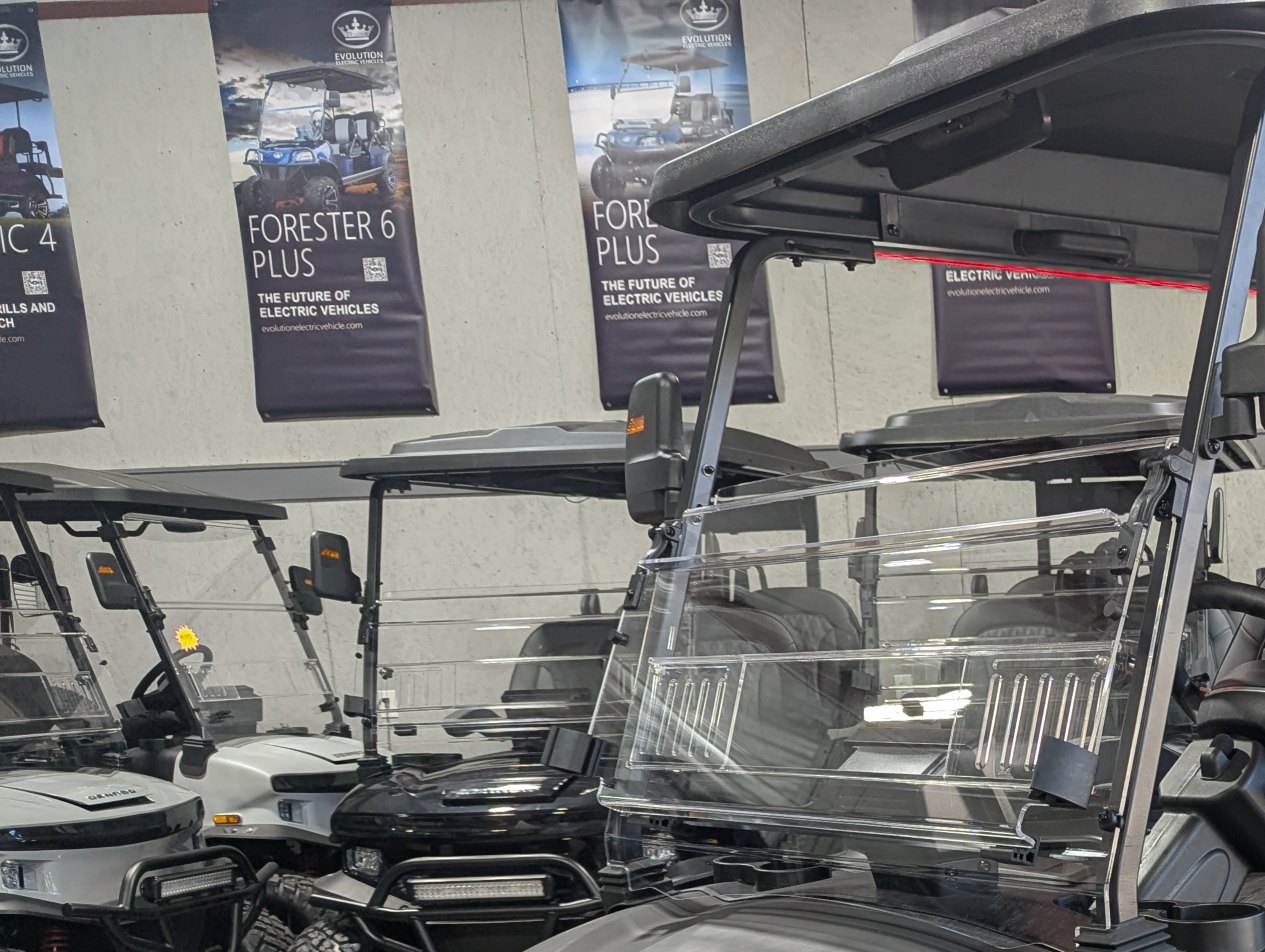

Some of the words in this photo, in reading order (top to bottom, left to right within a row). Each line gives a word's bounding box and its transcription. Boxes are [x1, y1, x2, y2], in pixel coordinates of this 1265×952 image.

[681, 33, 732, 44] EVOLUTION
[334, 51, 383, 61] EVOLUTION
[248, 210, 373, 244] FORESTER
[380, 209, 396, 239] 6
[39, 223, 57, 252] 4
[596, 233, 660, 266] PLUS
[252, 247, 315, 279] PLUS
[945, 268, 1003, 282] ELECTRIC
[601, 279, 626, 292] THE
[627, 278, 677, 291] FUTURE
[678, 276, 696, 289] OF
[946, 285, 1051, 297] evolutionelectricvehicle.com
[257, 292, 281, 304] THE
[284, 290, 332, 303] FUTURE
[334, 289, 351, 301] OF
[603, 292, 663, 306] ELECTRIC
[664, 290, 724, 304] VEHICLES
[30, 302, 56, 313] AND
[259, 304, 317, 318] ELECTRIC
[320, 302, 380, 316] VEHICLES
[604, 309, 708, 321] evolutionelectricvehicle.com
[261, 321, 364, 333] evolutionelectricvehicle.com
